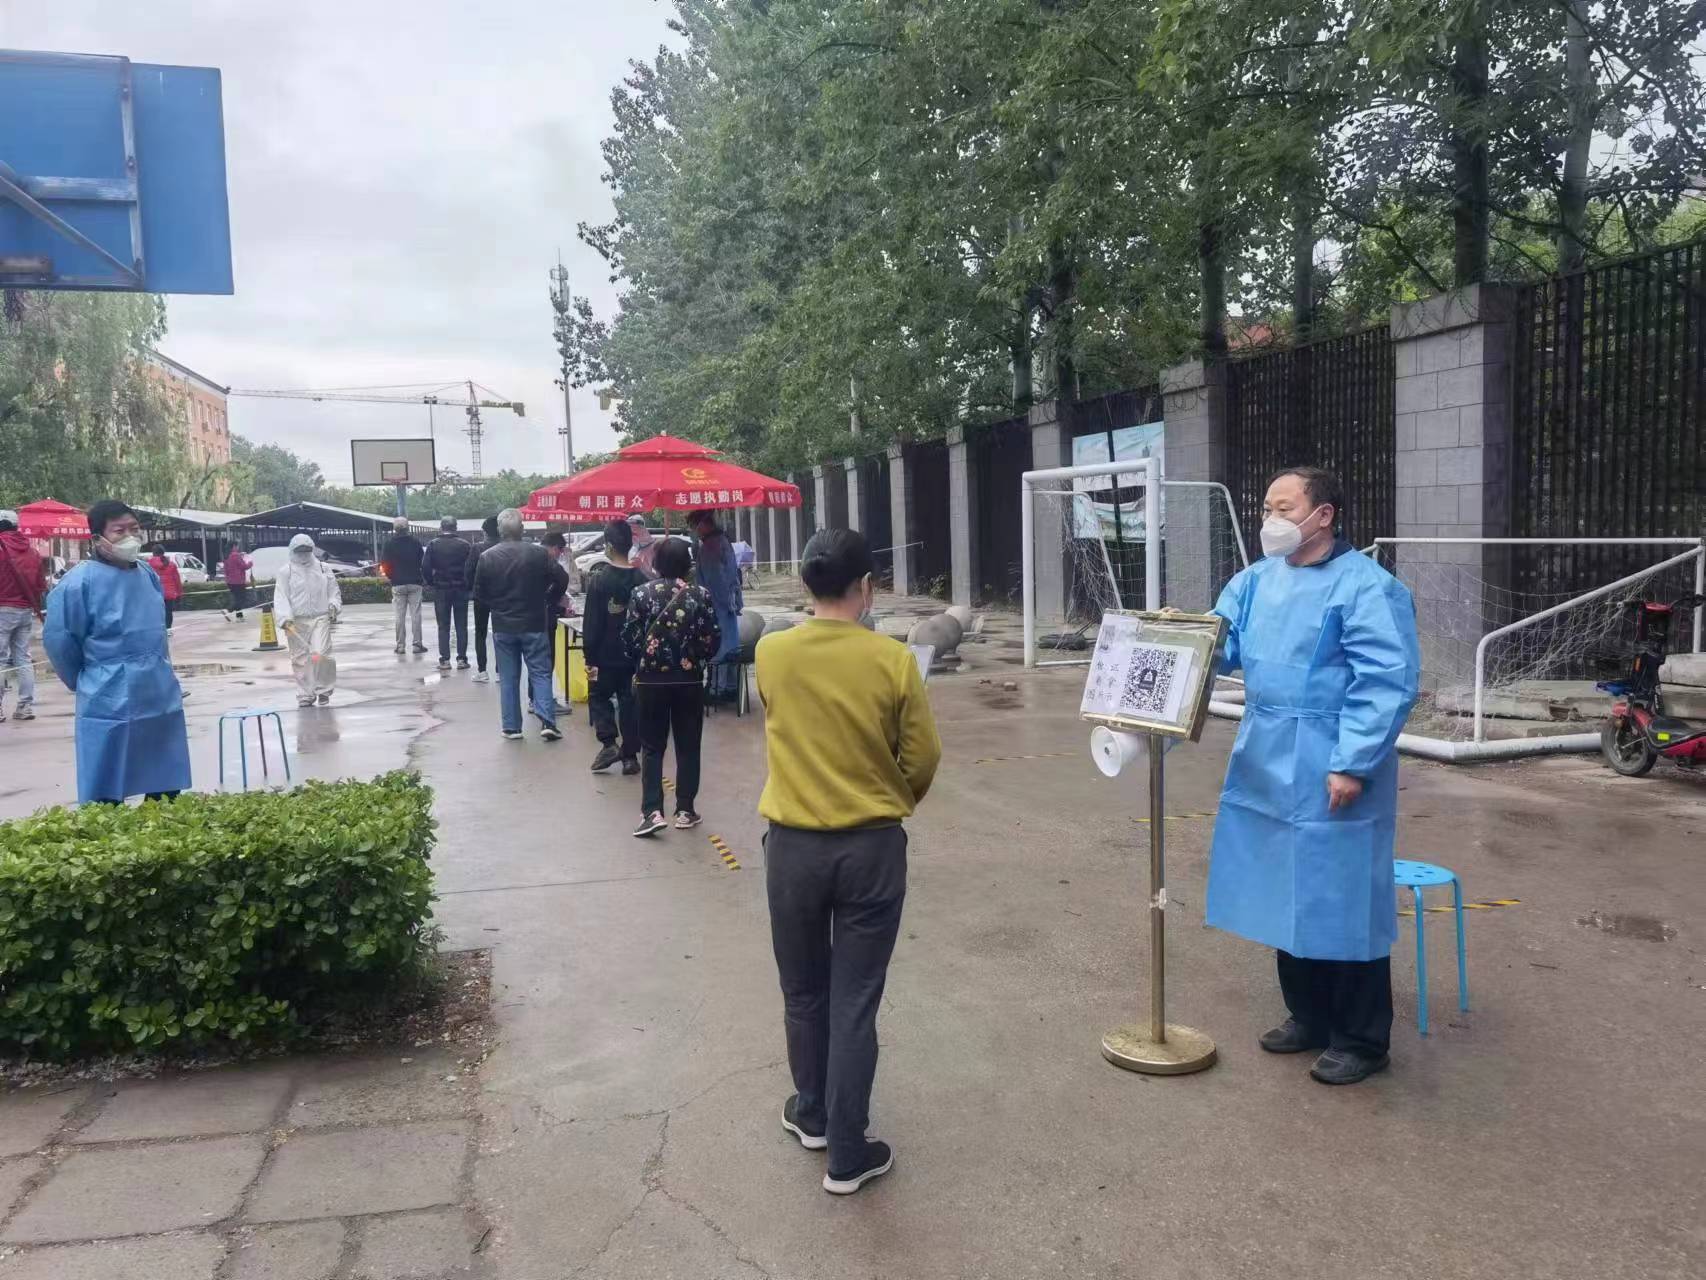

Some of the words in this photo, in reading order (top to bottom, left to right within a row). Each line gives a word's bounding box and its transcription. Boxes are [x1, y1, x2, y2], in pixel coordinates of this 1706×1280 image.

[579, 495, 643, 509] 朝阳群众
[675, 491, 743, 504] 志愿执勤岗
